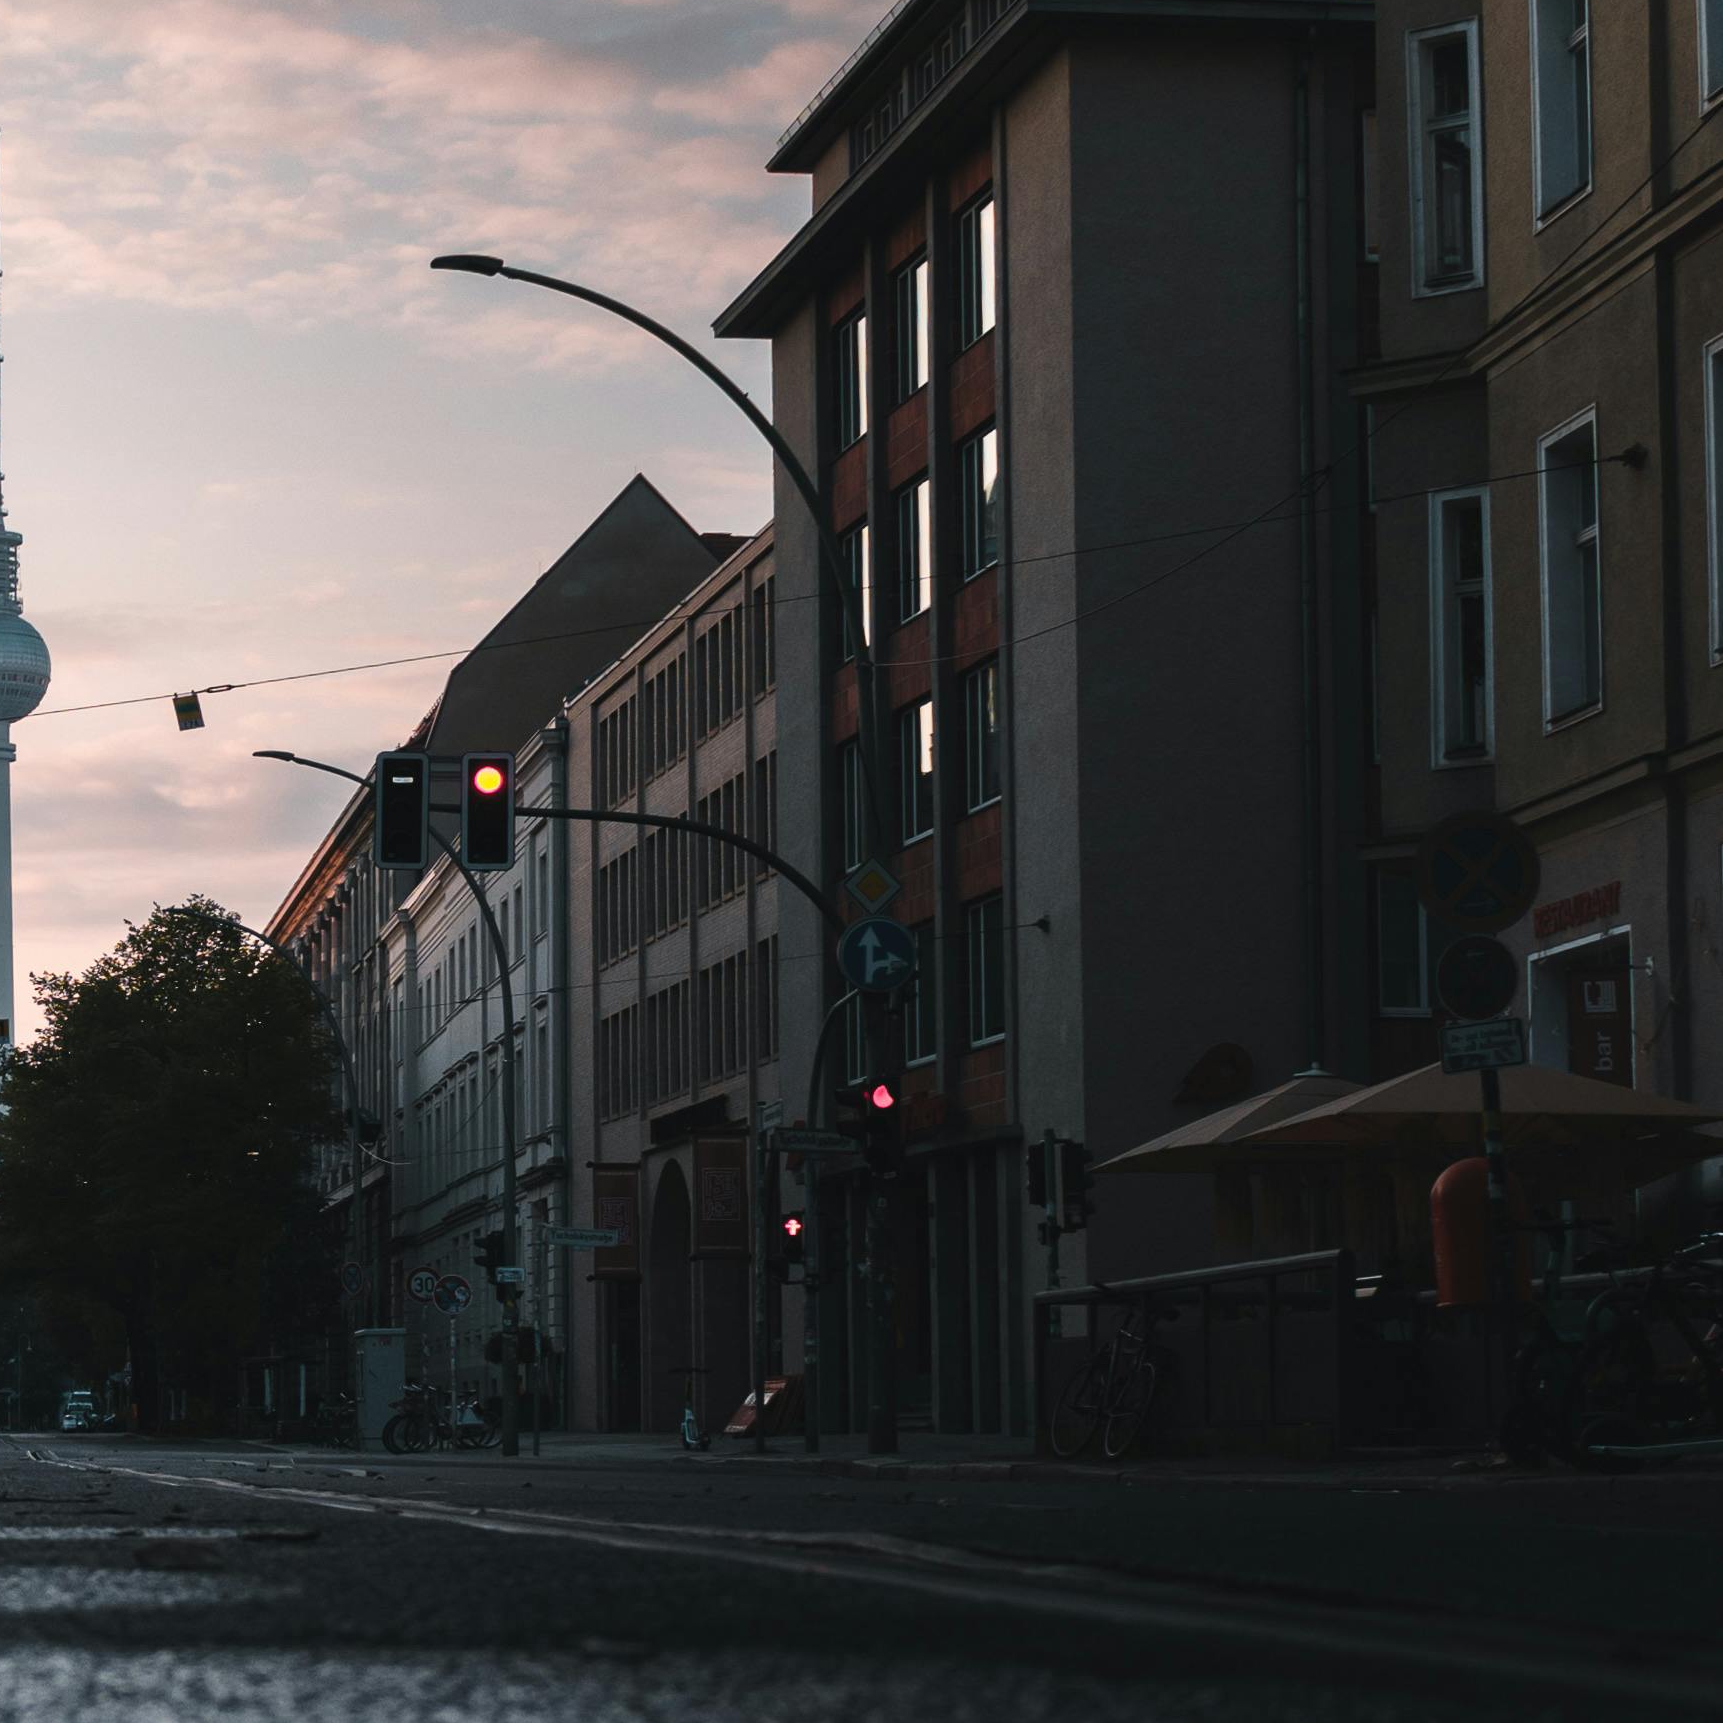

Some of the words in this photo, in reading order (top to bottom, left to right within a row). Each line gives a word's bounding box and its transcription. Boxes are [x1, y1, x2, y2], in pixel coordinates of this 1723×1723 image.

[1533, 880, 1621, 938] RESTAURANT
[1594, 1031, 1613, 1071] bar
[414, 1276, 435, 1294] 30
